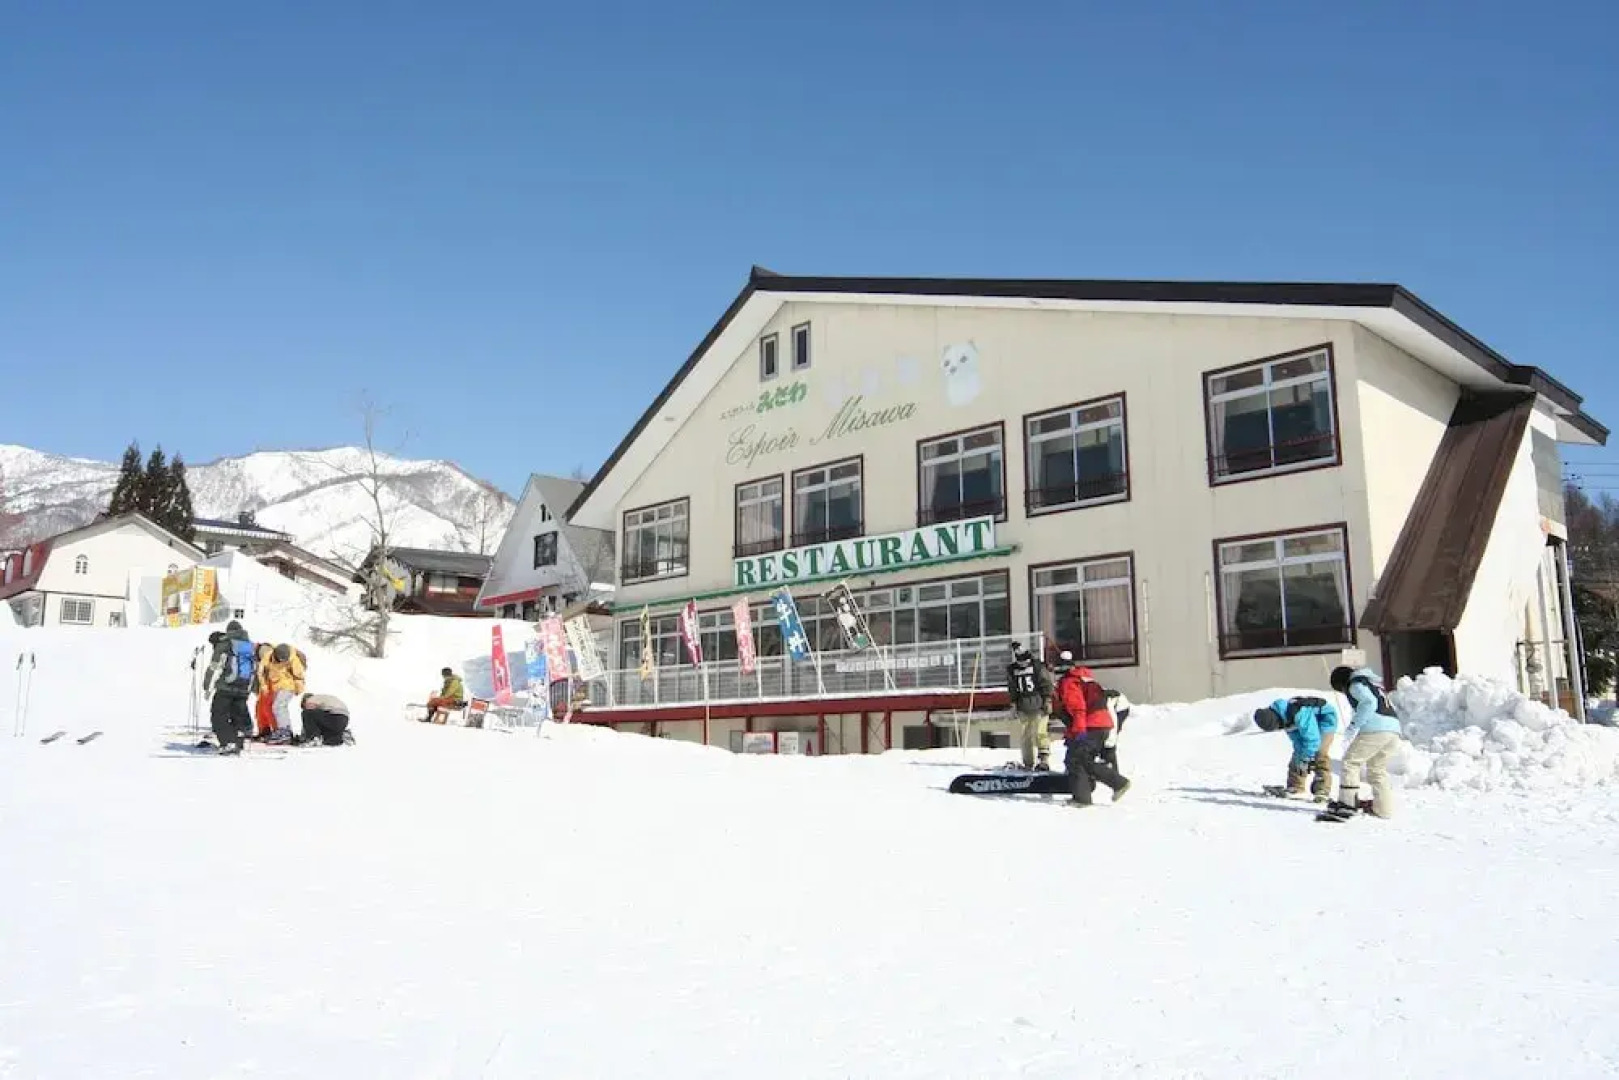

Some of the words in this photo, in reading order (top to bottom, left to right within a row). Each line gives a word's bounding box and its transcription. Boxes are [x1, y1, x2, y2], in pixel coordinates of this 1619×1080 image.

[725, 423, 800, 468] Espoir
[809, 395, 918, 445] Misawa
[735, 519, 990, 586] RESTAURANT
